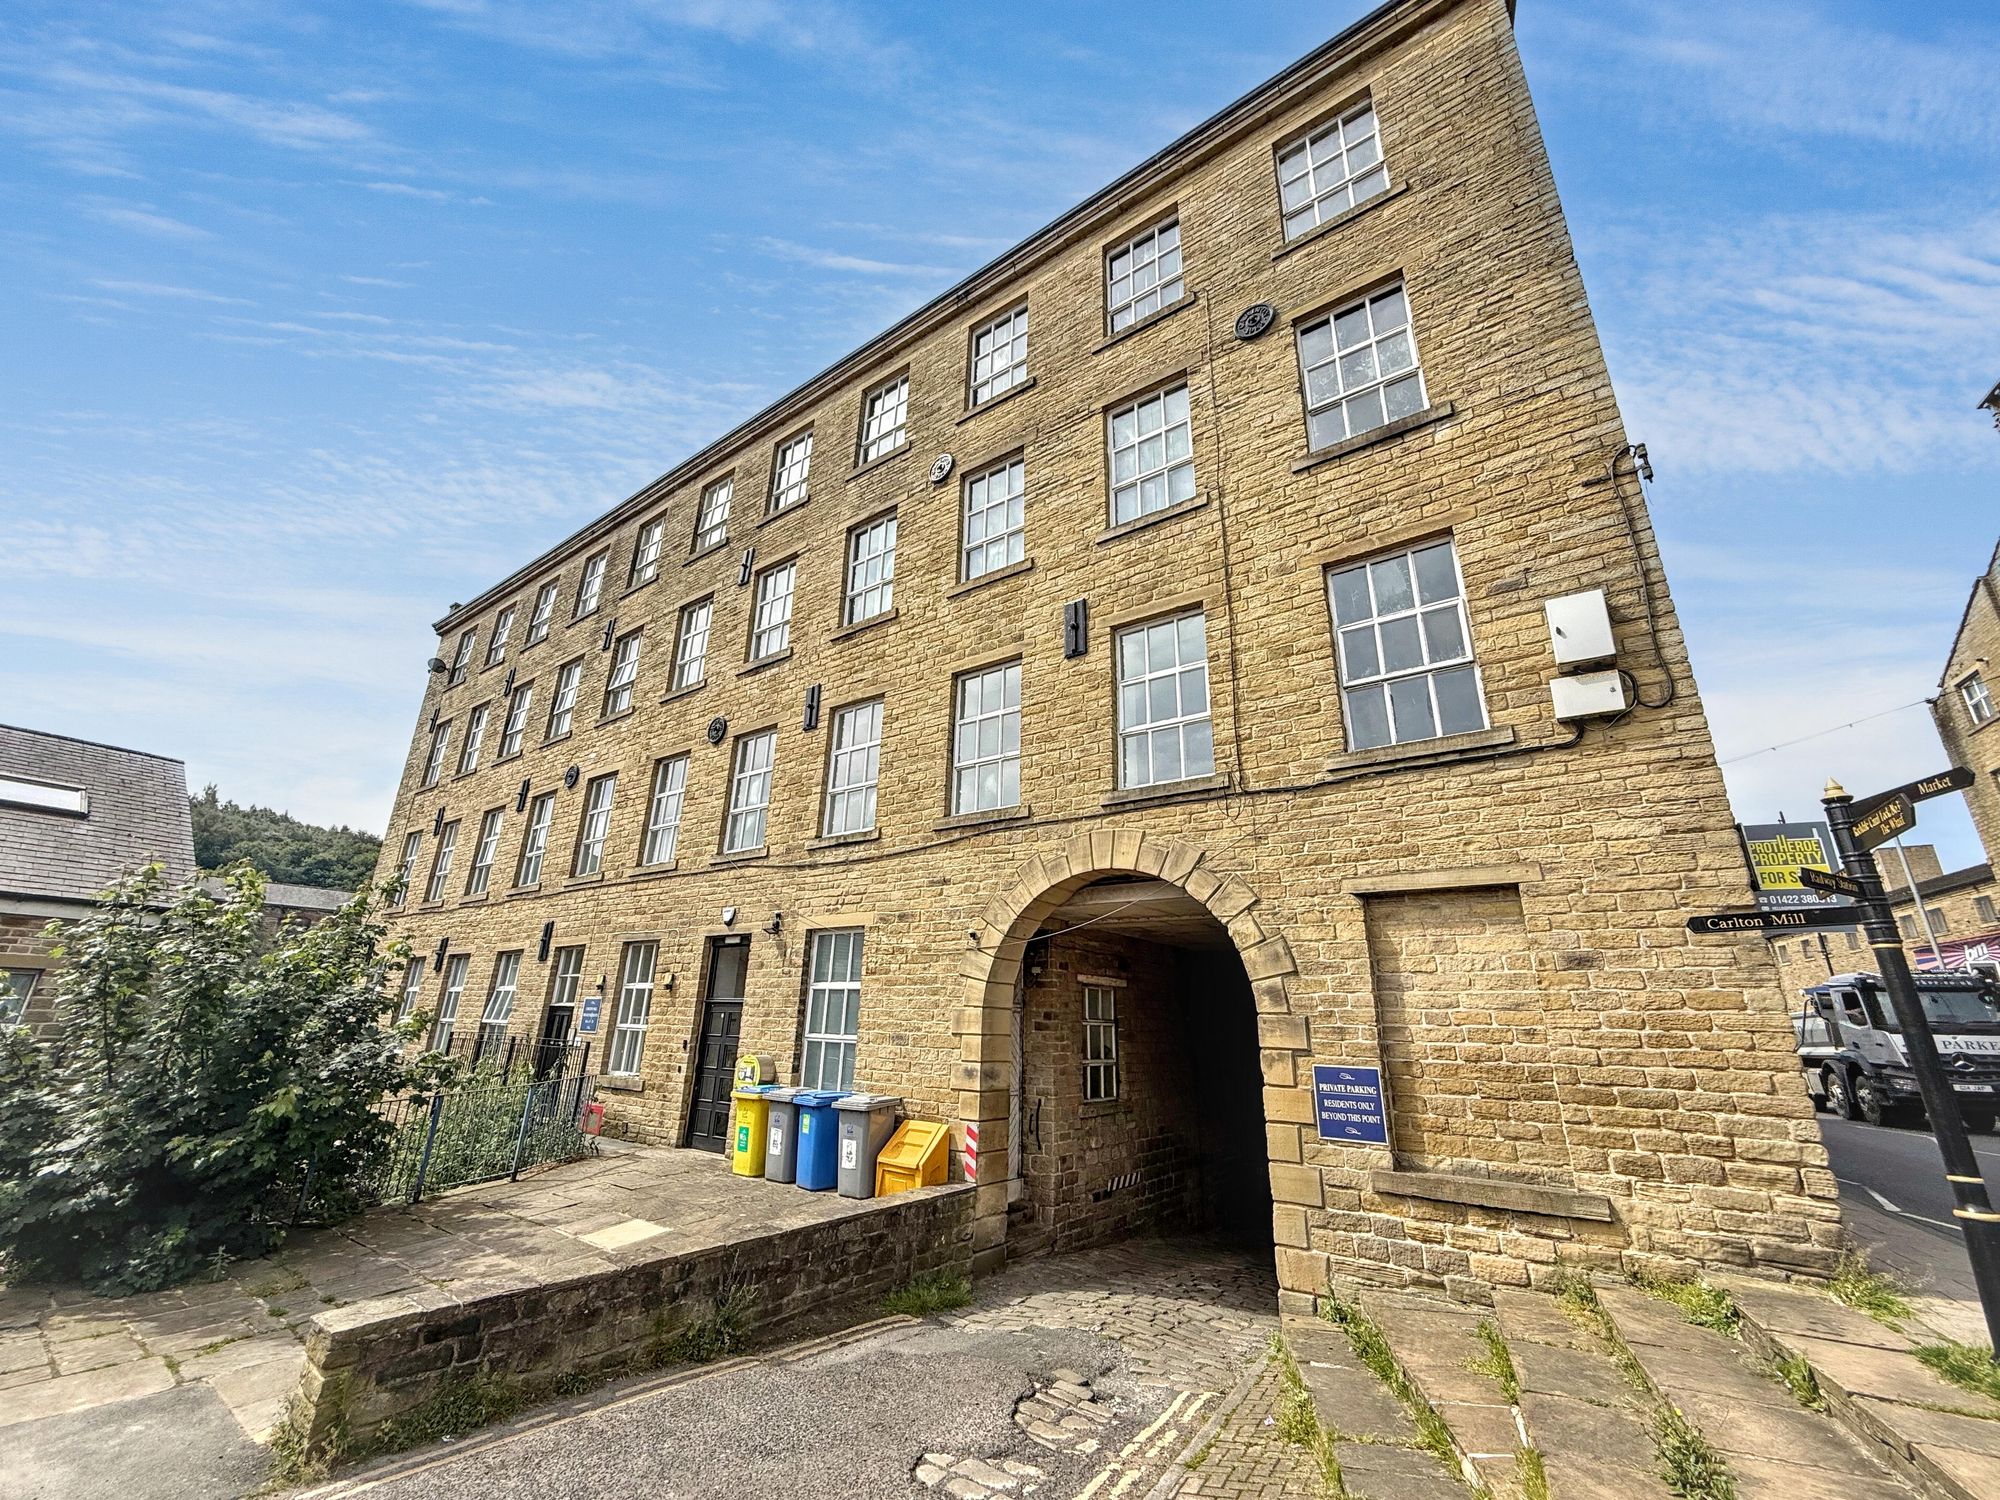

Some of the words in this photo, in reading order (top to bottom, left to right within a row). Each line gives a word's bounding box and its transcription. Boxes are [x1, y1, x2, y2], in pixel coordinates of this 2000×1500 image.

[1917, 777, 1952, 795] Market
[1748, 834, 1820, 854] PROTHEROE
[1751, 851, 1822, 866] PROPERTY
[1760, 871, 1786, 884] FOR
[1769, 895, 1800, 904] 01422
[1707, 918, 1764, 930] Carlton
[1770, 913, 1807, 925] Mill
[1942, 1040, 2000, 1051] PARKE
[1319, 1083, 1346, 1093] PRIVATE
[1347, 1085, 1377, 1094] PARKING
[1323, 1099, 1357, 1109] RESIDENTS
[1358, 1102, 1375, 1110] ONLY
[1321, 1111, 1347, 1120] BEYOND
[1347, 1113, 1361, 1122] THIS
[1362, 1115, 1381, 1124] POINT
